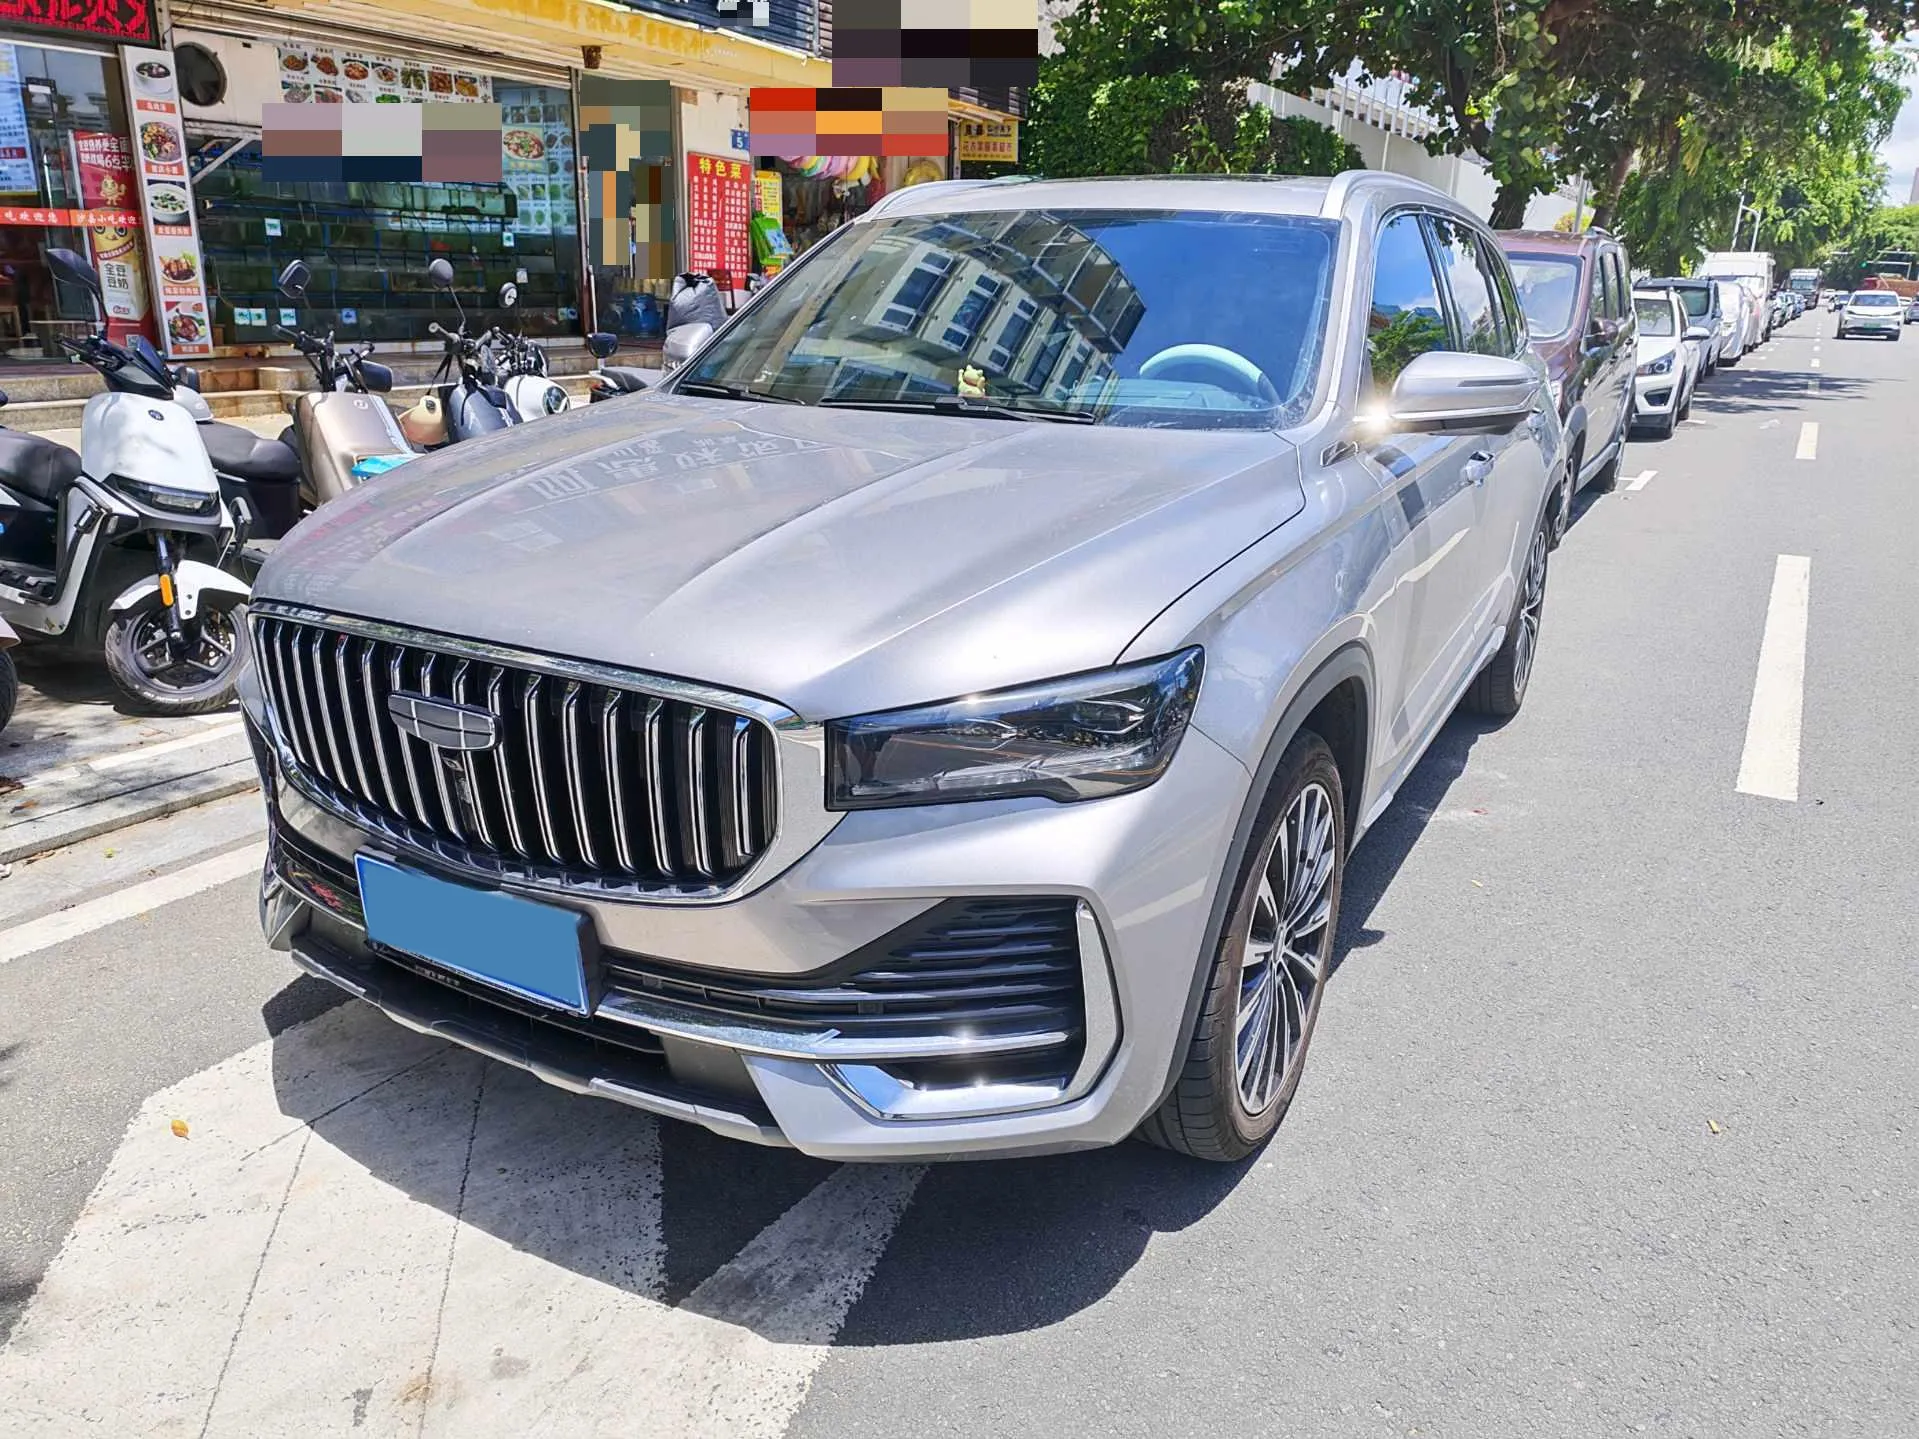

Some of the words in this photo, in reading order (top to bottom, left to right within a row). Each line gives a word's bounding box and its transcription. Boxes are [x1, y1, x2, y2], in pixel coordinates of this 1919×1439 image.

[736, 136, 744, 148] 5
[699, 157, 742, 179] 特色菜
[104, 262, 128, 277] 全豆
